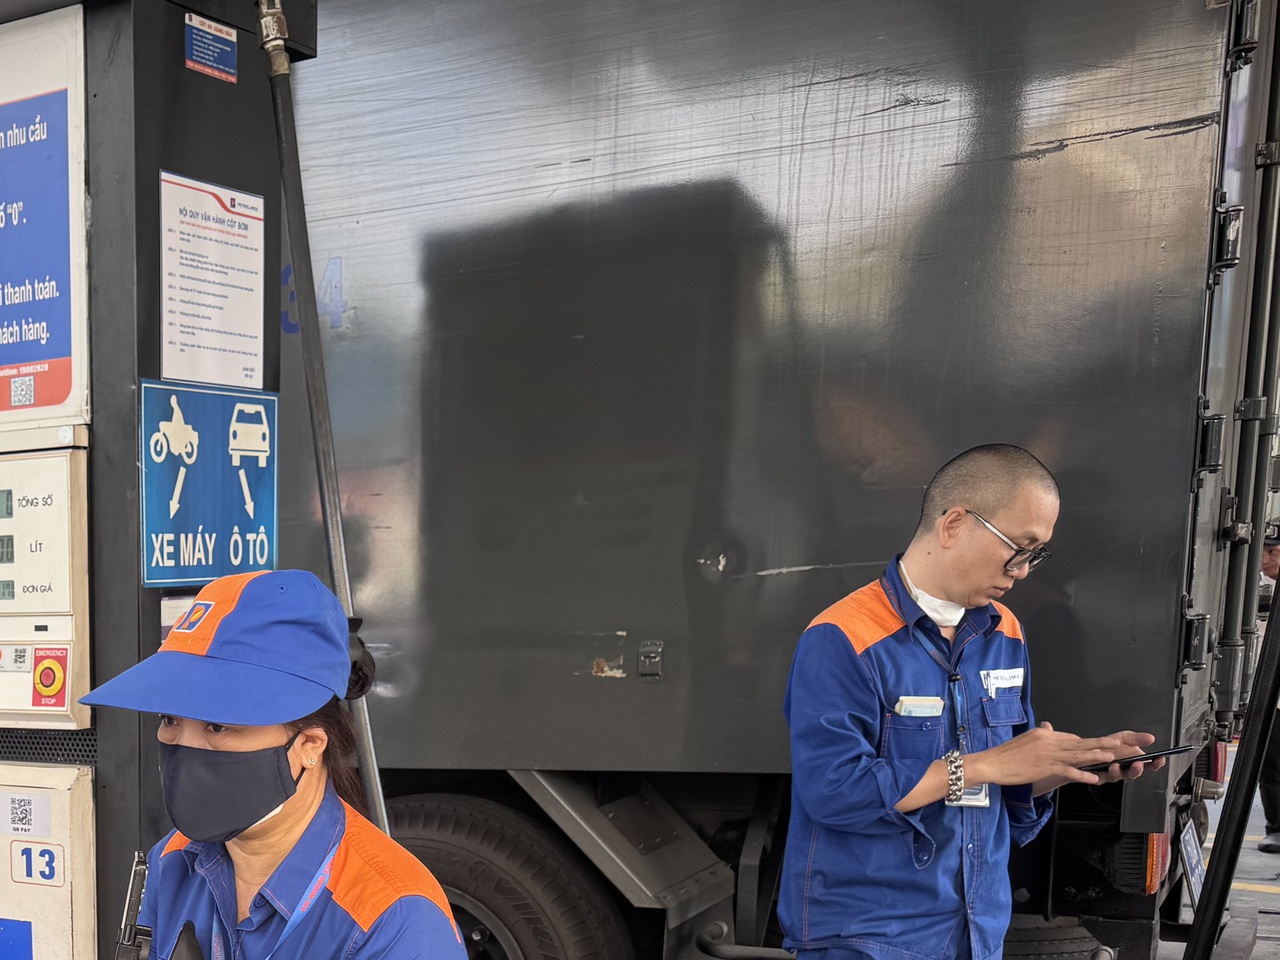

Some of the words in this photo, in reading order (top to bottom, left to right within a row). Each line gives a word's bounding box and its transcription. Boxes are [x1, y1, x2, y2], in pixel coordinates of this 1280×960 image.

[6, 123, 26, 147] nhu
[4, 279, 32, 305] thanh
[34, 275, 59, 300] toán.
[21, 317, 49, 344] hàng.
[30, 540, 43, 552] LÍT
[151, 533, 175, 567] XE
[180, 525, 216, 566] MÁY
[229, 526, 243, 566] Ô
[246, 525, 268, 565] TÔ
[39, 583, 53, 593] GIÁ
[21, 847, 56, 880] 13
